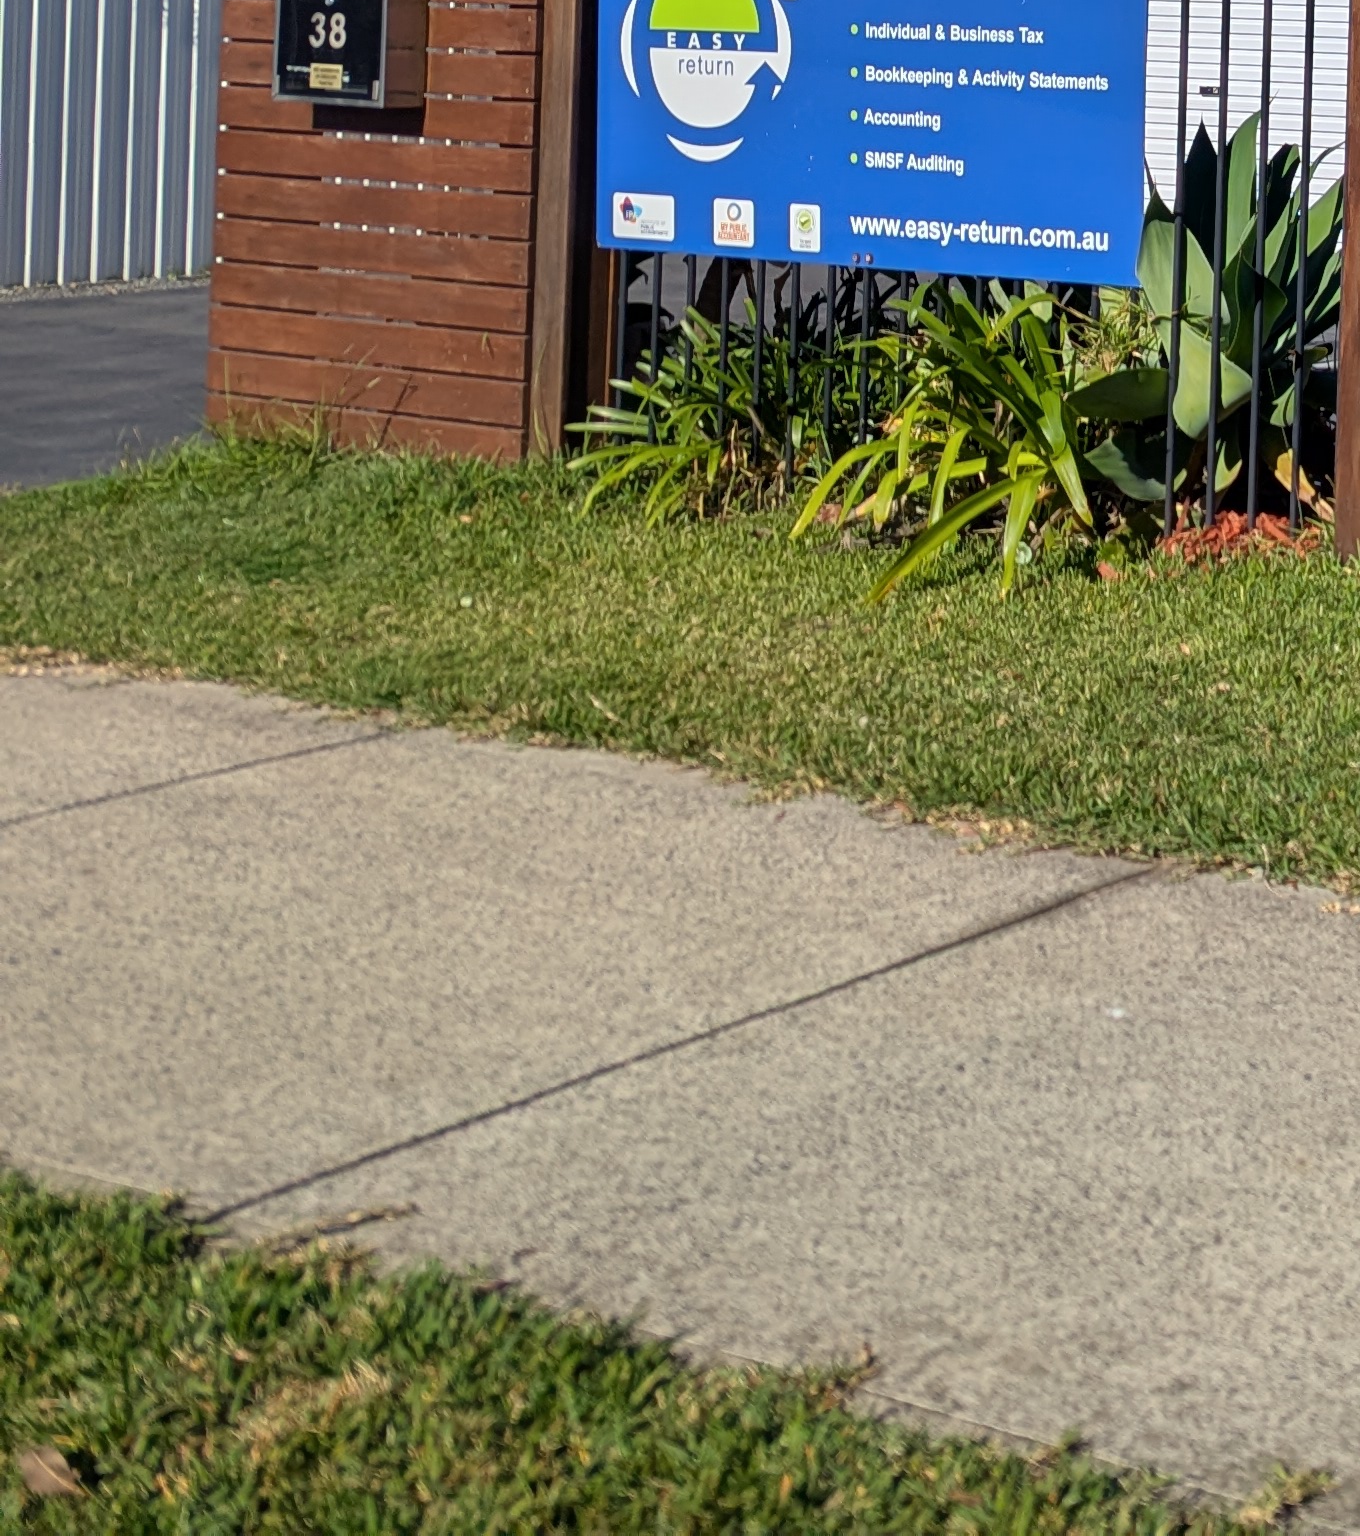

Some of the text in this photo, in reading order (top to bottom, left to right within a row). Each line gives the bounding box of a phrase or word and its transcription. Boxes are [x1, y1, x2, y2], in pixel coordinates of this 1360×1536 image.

[308, 11, 347, 50] 38
[667, 32, 746, 50] EASY
[865, 22, 1044, 44] Individual & Business Tax
[678, 55, 735, 76] return
[865, 65, 1109, 92] Bookkeeping & Activity Statements
[864, 108, 941, 132] Accounting
[865, 151, 964, 177] SMSF Auditing
[849, 215, 1109, 252] www.easy-return.com.au
